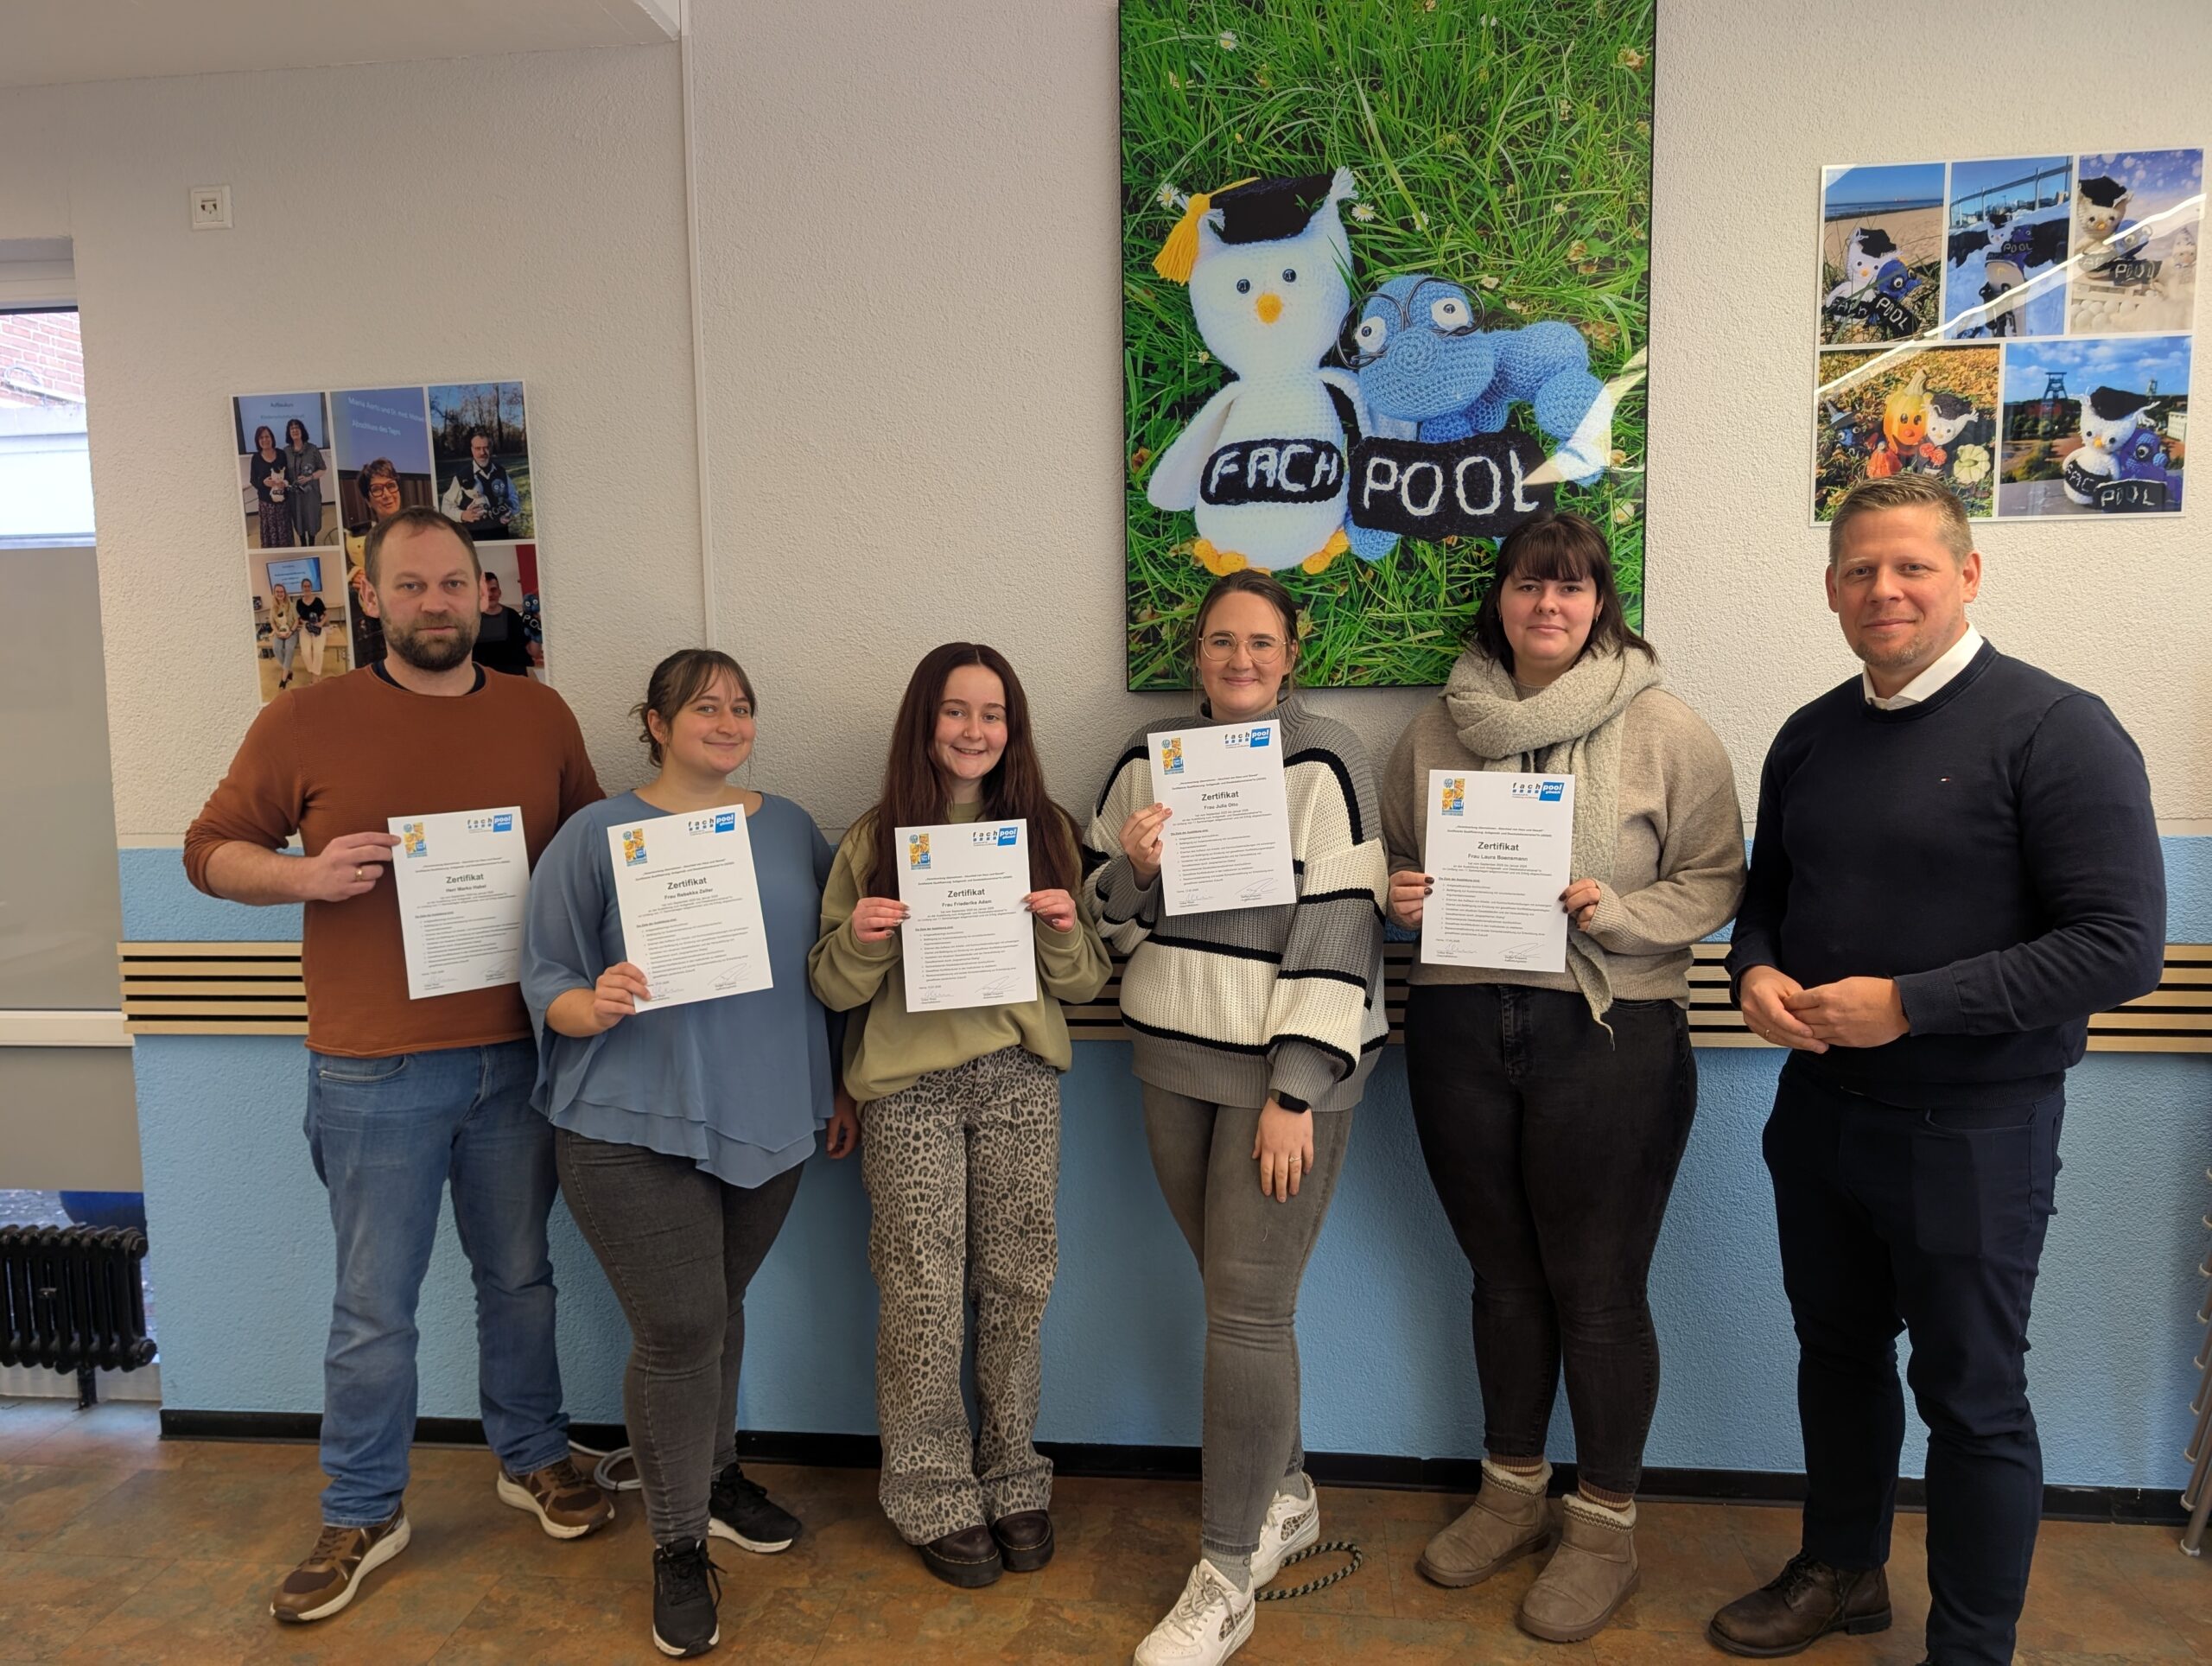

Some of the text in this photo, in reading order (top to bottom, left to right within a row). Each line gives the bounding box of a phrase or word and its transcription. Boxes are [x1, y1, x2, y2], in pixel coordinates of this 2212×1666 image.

[1211, 443, 1540, 517] FACH POOL
[1252, 729, 1268, 739] pool
[1201, 791, 1239, 802] Zertifikat
[716, 814, 734, 824] pool
[1478, 842, 1519, 851] Zertifikat
[446, 873, 484, 883] Zertifikat
[667, 877, 707, 890] Zertifikat
[947, 888, 985, 898] Zertifikat
